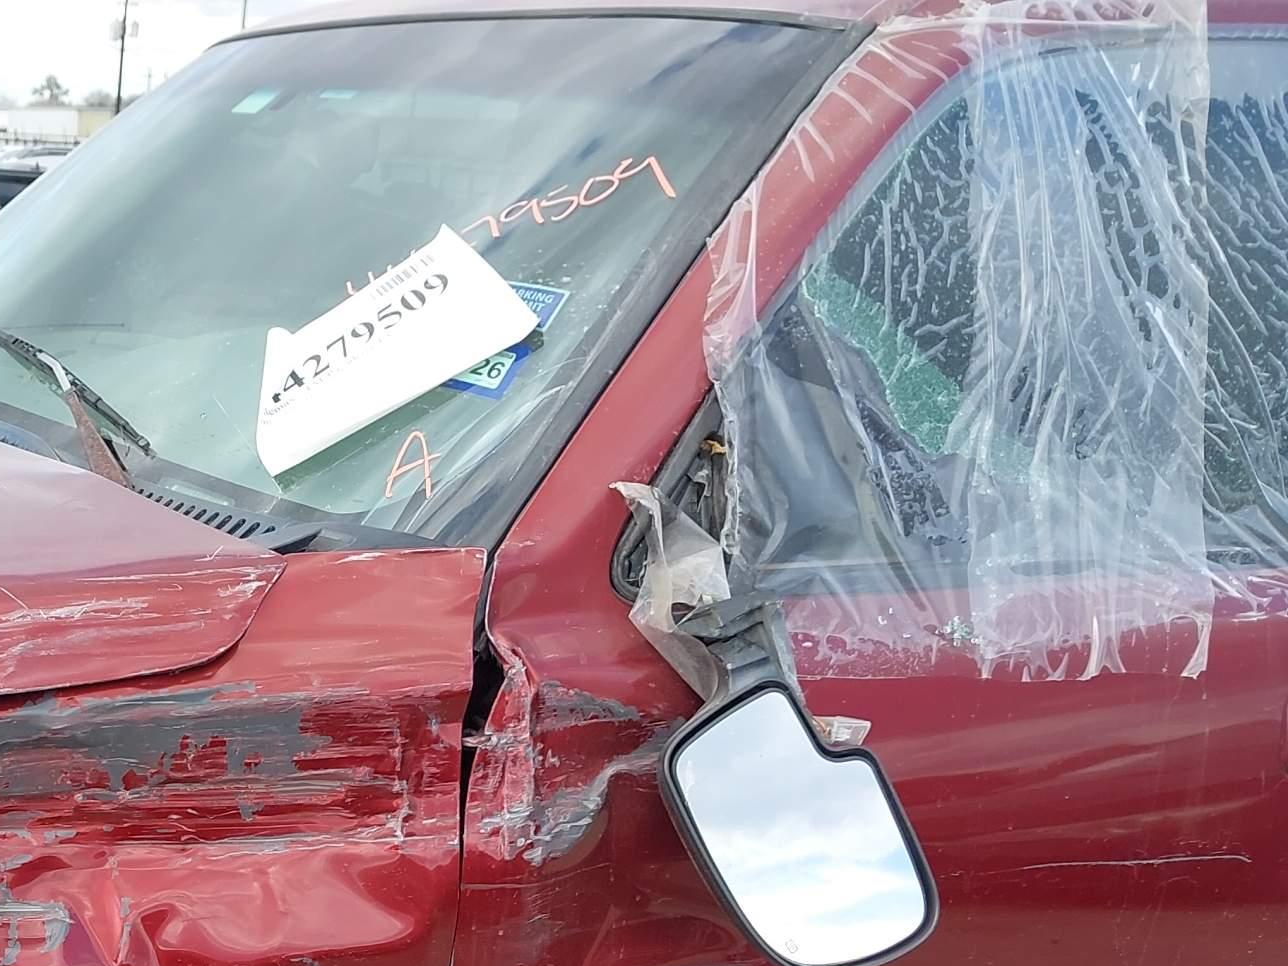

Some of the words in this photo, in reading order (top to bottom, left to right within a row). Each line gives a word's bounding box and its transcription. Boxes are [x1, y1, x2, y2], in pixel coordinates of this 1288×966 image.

[513, 288, 555, 304] RKING
[469, 358, 505, 380] 26
[385, 431, 441, 500] A
